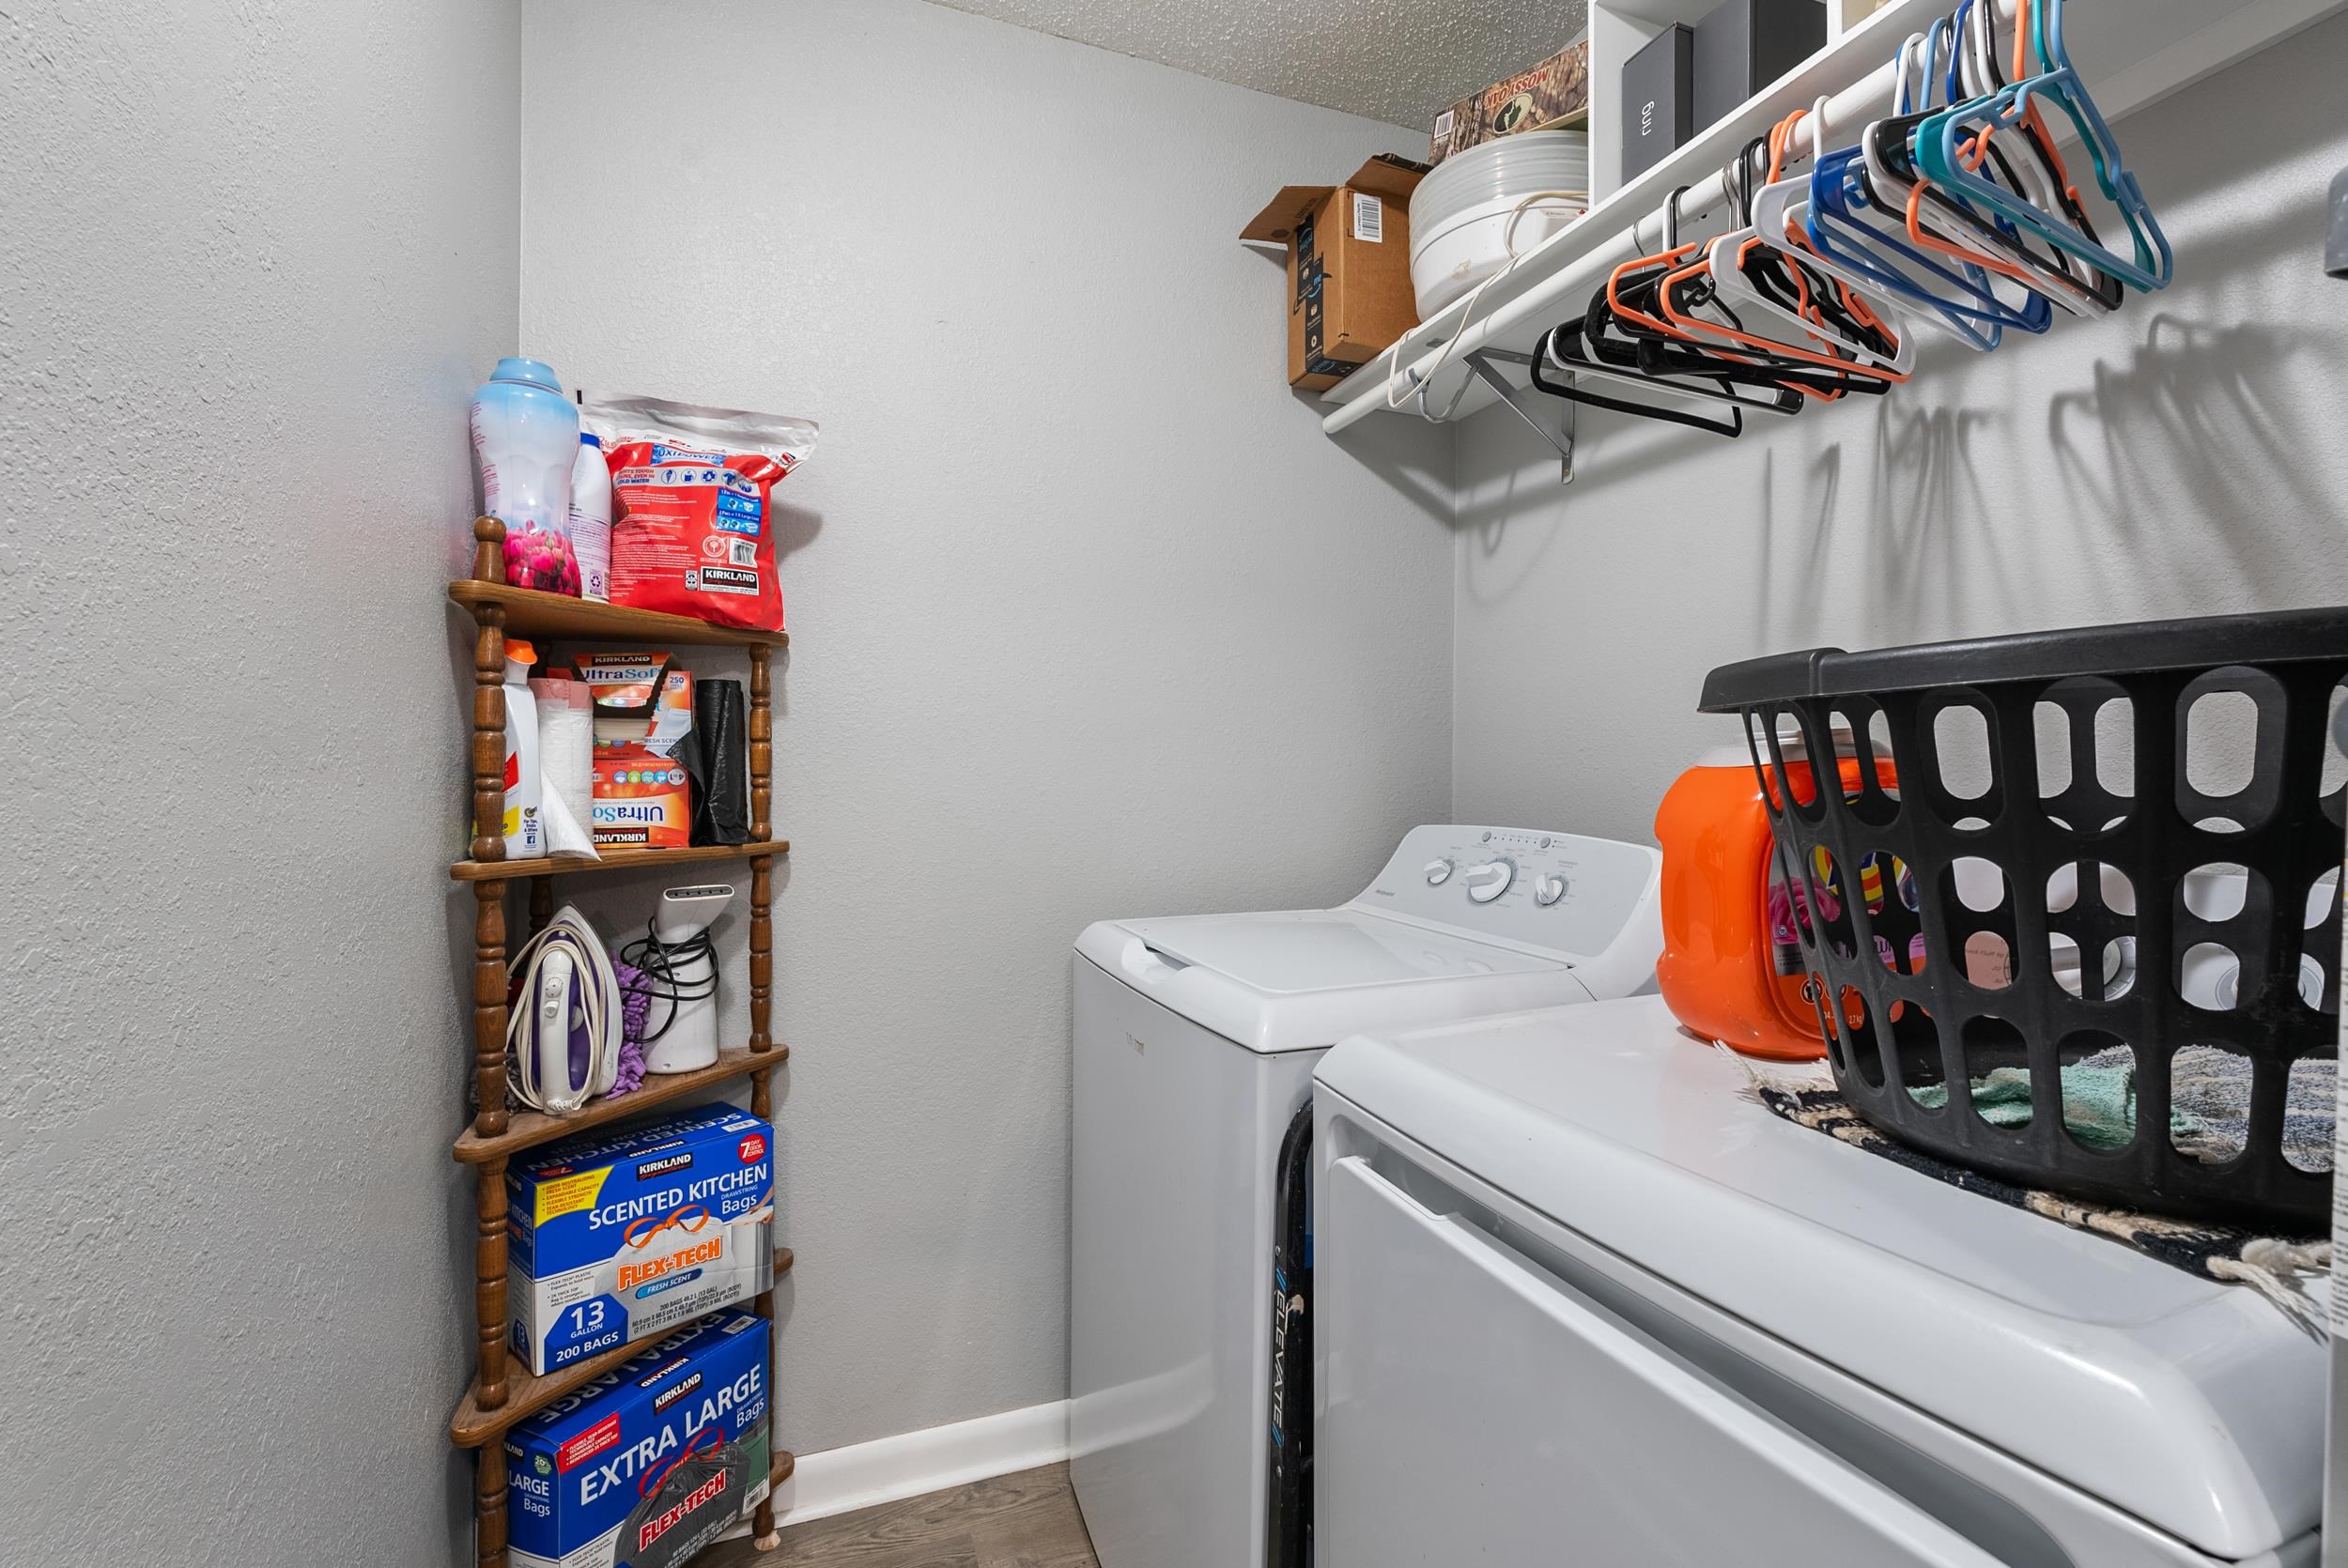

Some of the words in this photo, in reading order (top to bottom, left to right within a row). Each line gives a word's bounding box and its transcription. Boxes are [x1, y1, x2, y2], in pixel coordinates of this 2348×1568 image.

[1641, 100, 1655, 136] ring
[705, 569, 756, 583] KIRKLAND
[595, 655, 650, 664] KIRKLAND
[593, 806, 664, 822] UltraSo
[740, 1141, 750, 1159] 7
[747, 1148, 765, 1158] CONTROL
[639, 1153, 691, 1176] KIRKLAND
[588, 1187, 684, 1231] SCENTED
[688, 1162, 767, 1203] KITCHEN
[720, 1184, 759, 1200] DRAWSTRING
[721, 1193, 758, 1215] Bags
[617, 1235, 723, 1292] FLEX-TECH
[646, 1281, 669, 1294] FRESH
[670, 1272, 692, 1287] SCENT
[570, 1300, 605, 1331] 13
[659, 1302, 670, 1312] 200
[670, 1298, 683, 1307] BAGS
[570, 1322, 604, 1340] GALLON
[556, 1345, 580, 1363] 200
[583, 1331, 619, 1353] BAGS
[1274, 1289, 1286, 1428] ELEVATE
[655, 1372, 702, 1408] KIRKLAND
[736, 1397, 765, 1428] Bags
[580, 1423, 678, 1507] EXTRA
[685, 1362, 761, 1439] LARGE
[509, 1469, 549, 1497] LARGE
[524, 1498, 550, 1517] Bags
[639, 1468, 726, 1554] FLEX-TECH
